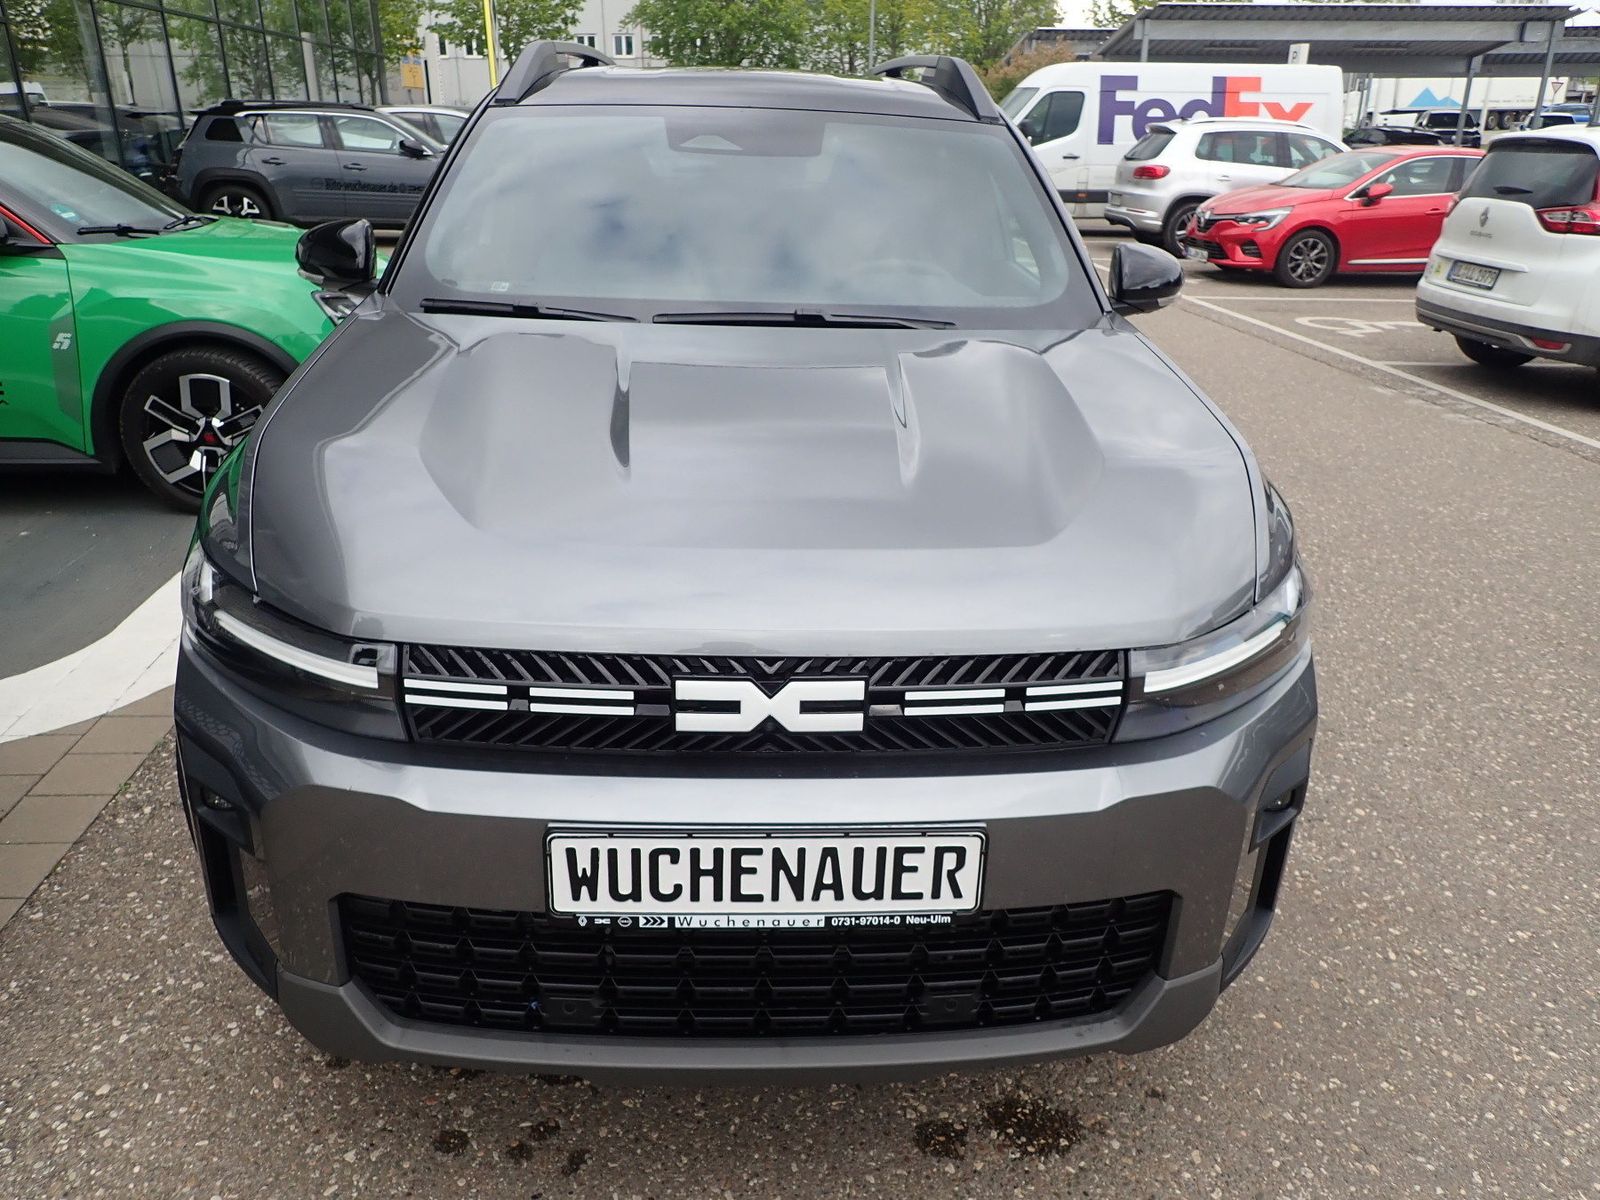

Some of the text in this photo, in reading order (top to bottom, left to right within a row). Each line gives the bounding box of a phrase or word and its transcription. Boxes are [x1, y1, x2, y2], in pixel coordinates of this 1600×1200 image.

[565, 845, 967, 902] WUCHENAUER
[677, 914, 951, 928] Wuchenauer 0731-97014-0 Neu-Ulm
